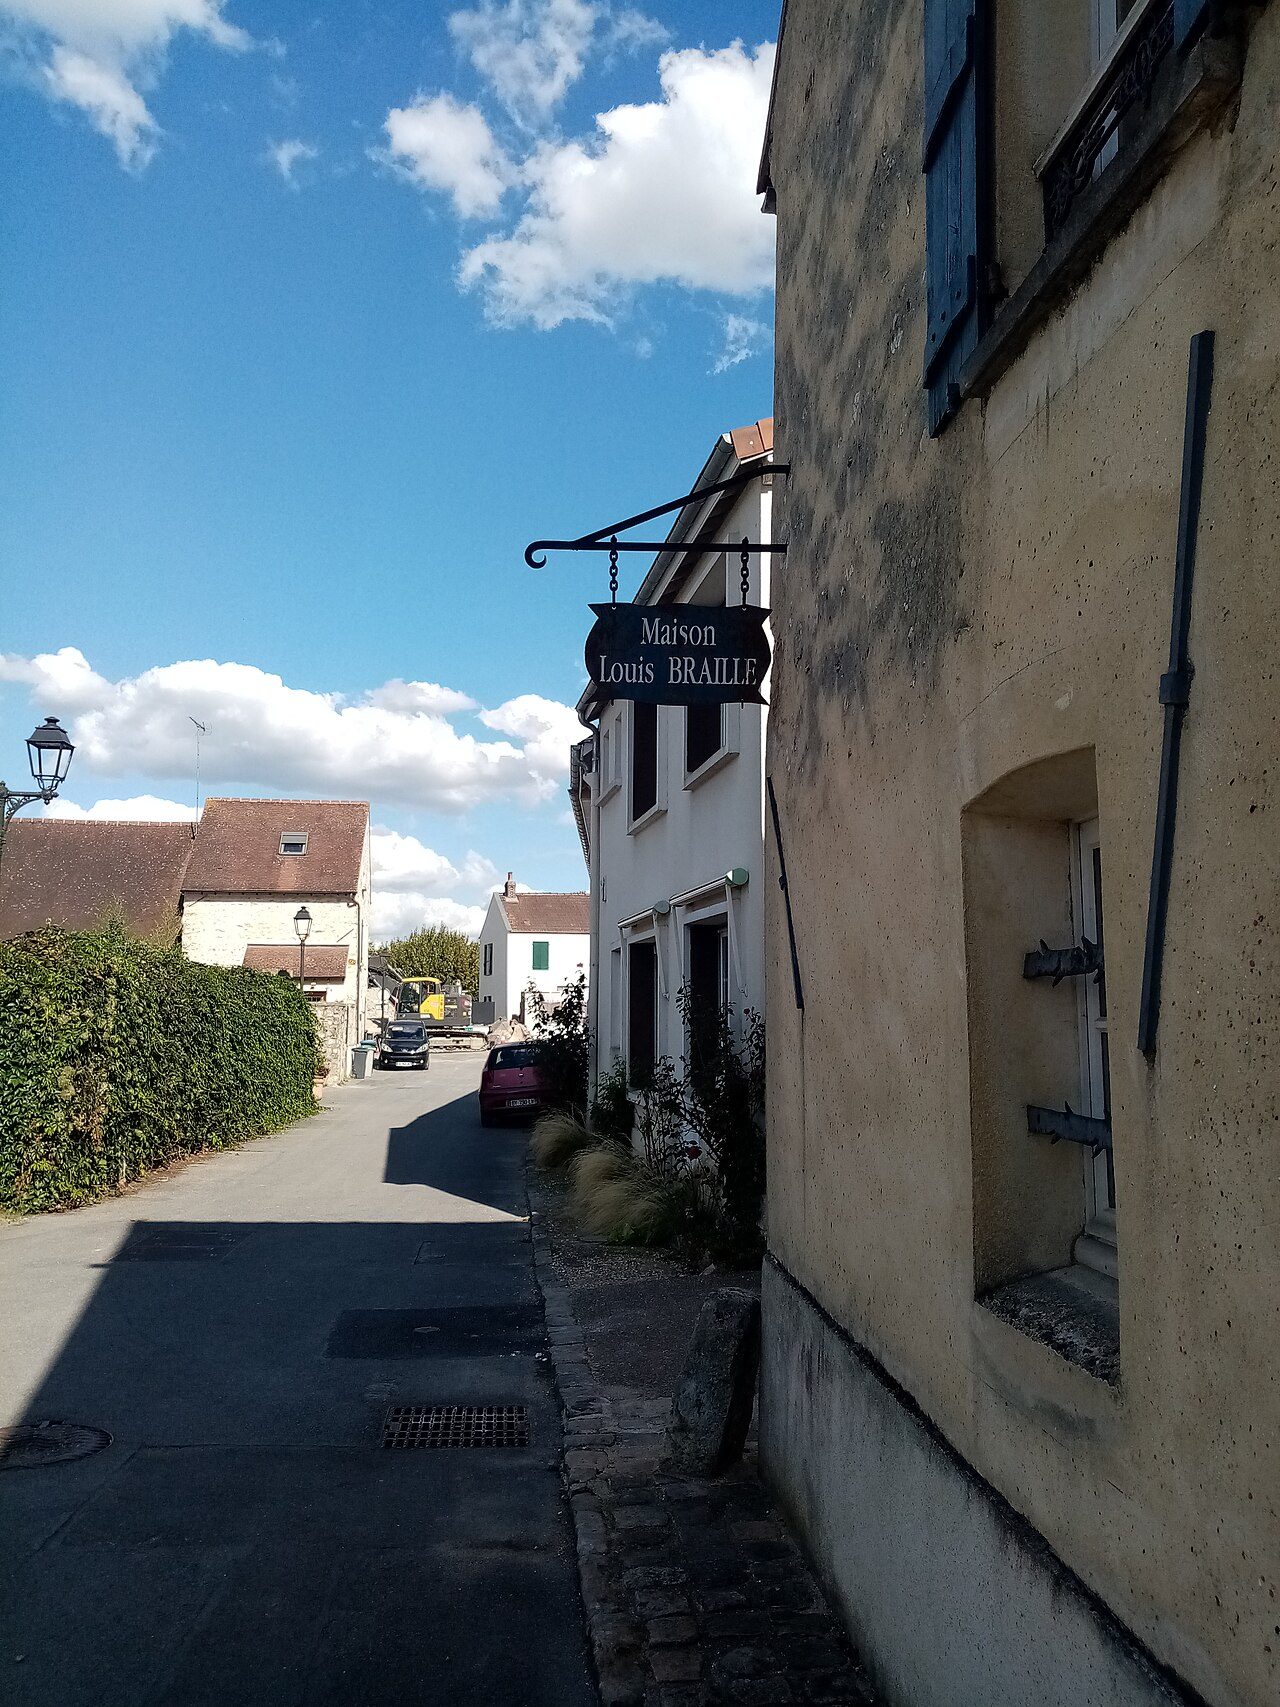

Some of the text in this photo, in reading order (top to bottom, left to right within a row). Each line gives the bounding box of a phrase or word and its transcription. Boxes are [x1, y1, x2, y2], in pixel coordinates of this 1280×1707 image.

[640, 617, 717, 646] Maison
[599, 655, 757, 686] Louis BRAILLE
